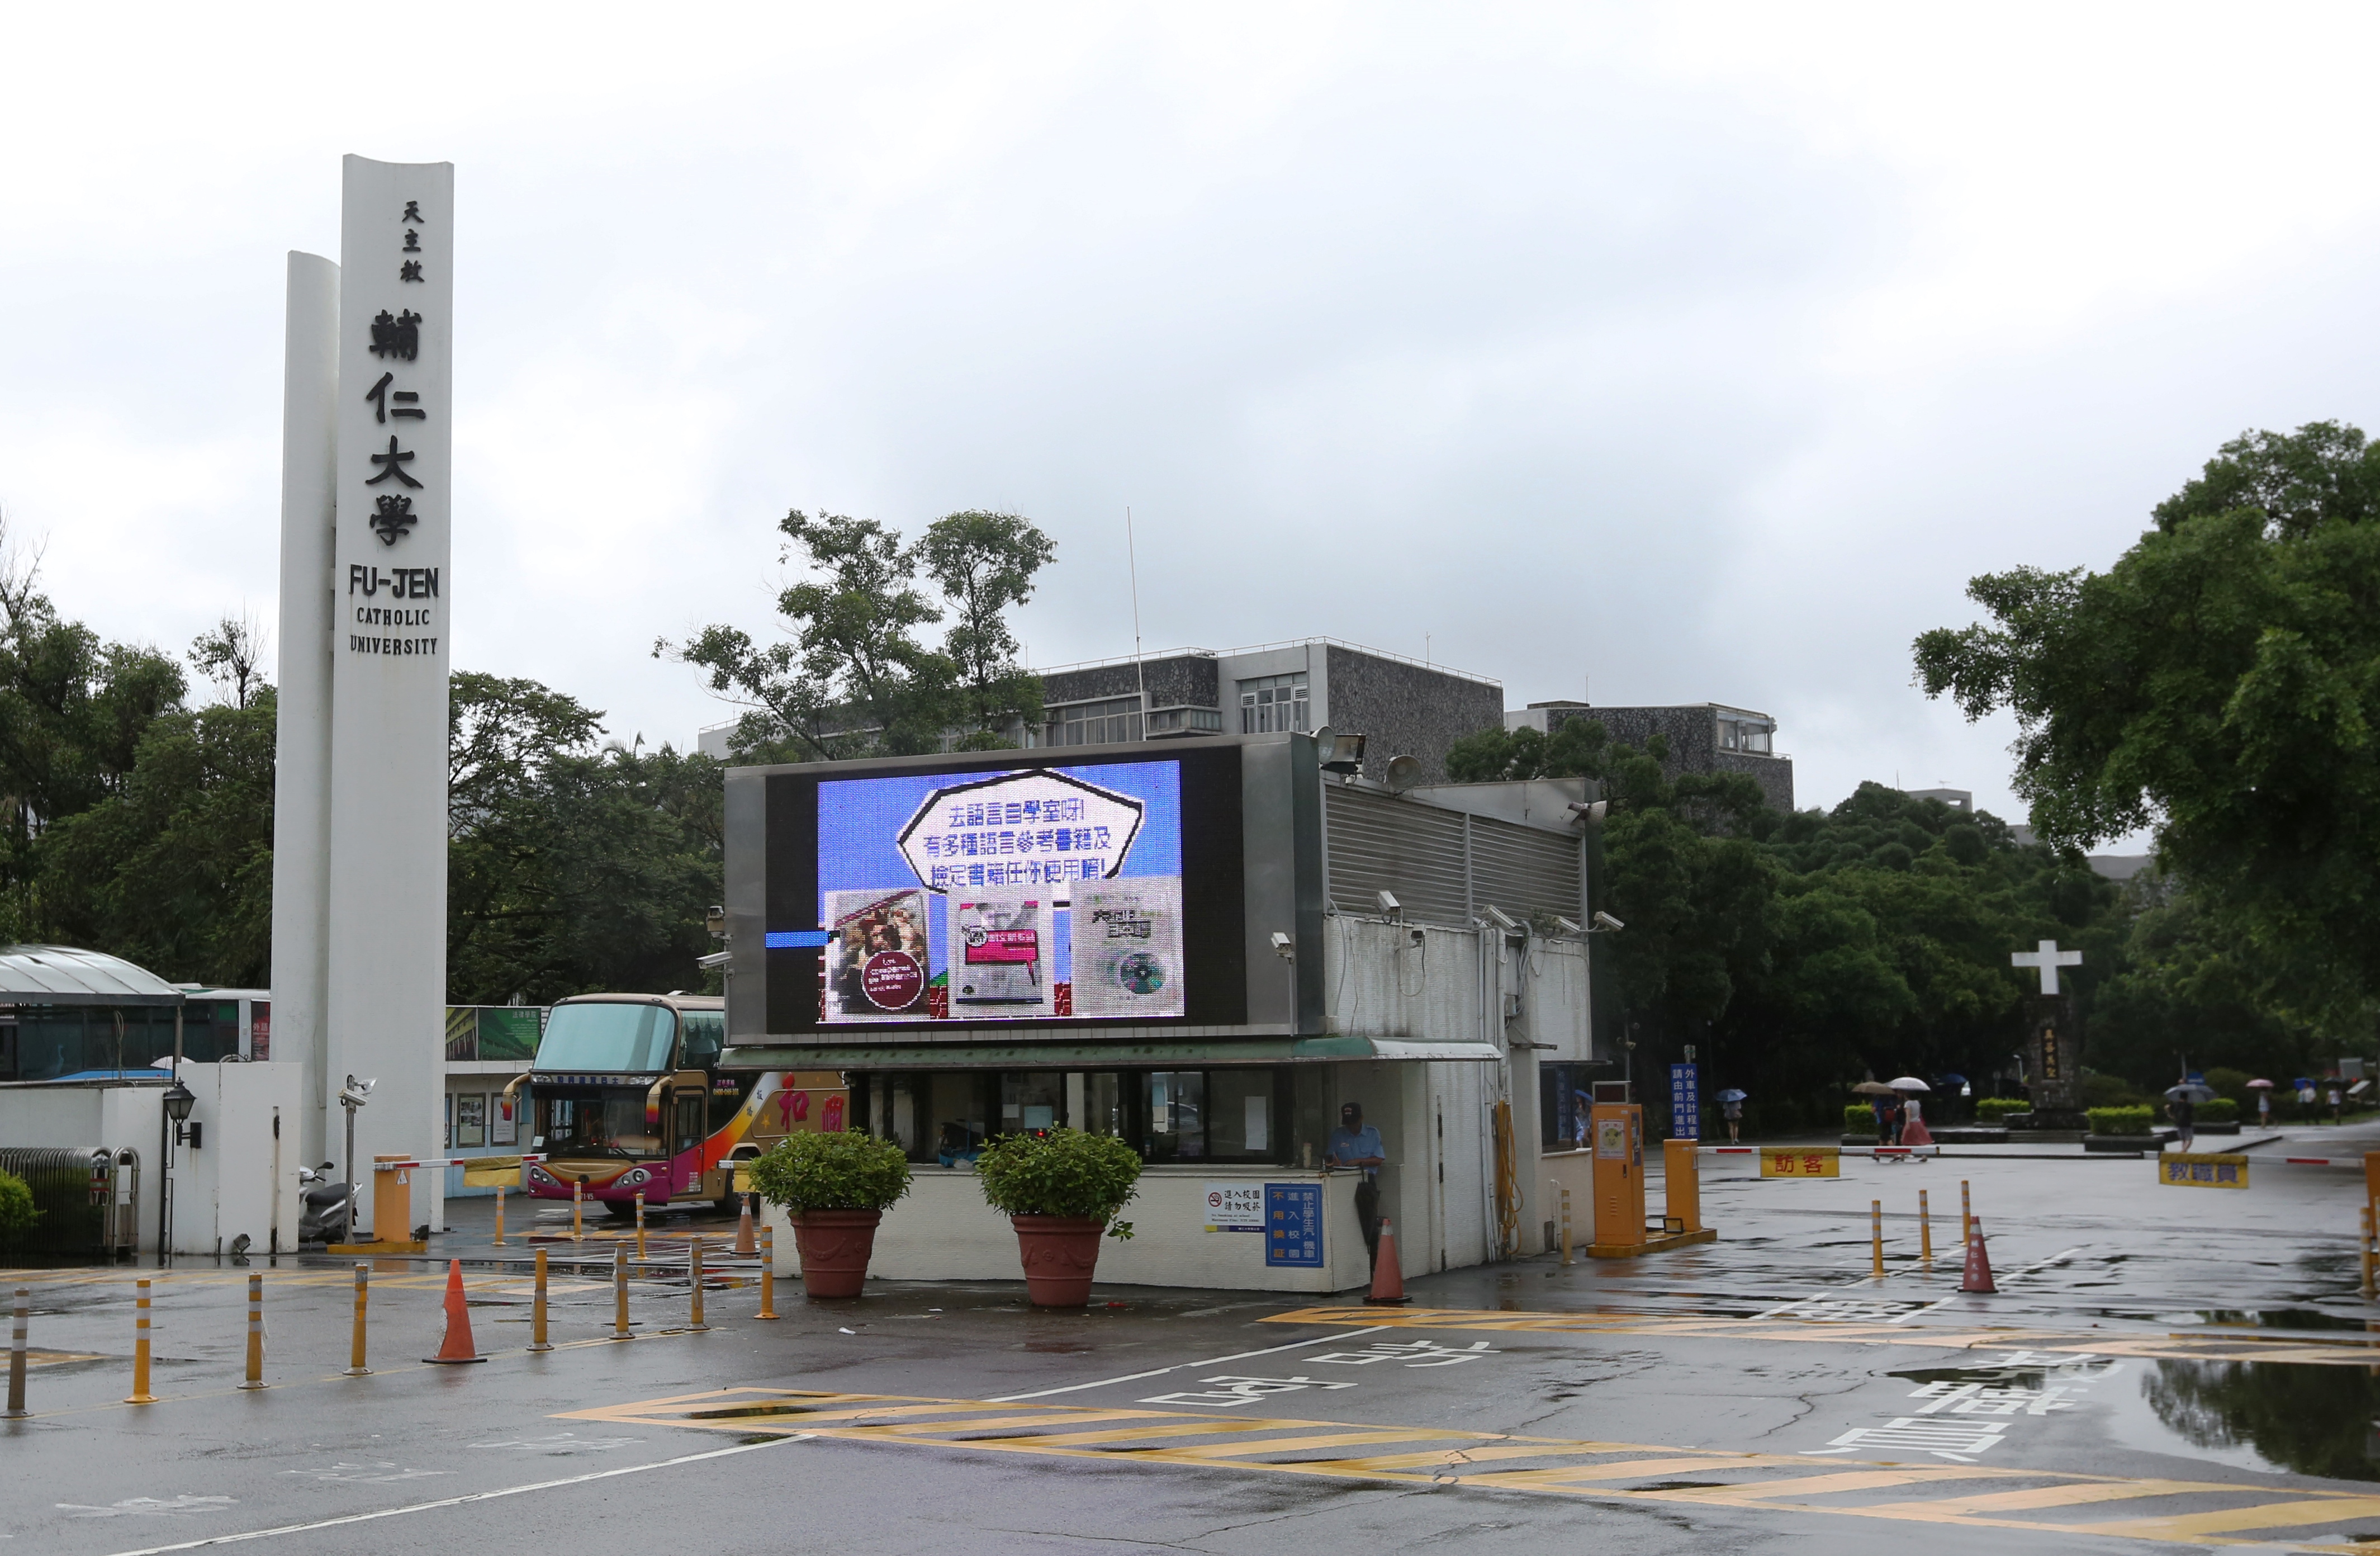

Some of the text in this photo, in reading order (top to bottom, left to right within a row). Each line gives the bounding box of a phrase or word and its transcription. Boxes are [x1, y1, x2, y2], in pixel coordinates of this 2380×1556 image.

[400, 200, 425, 282] 天主教
[365, 308, 426, 546] 輔仁大學
[349, 564, 439, 599] FU-JEN
[357, 607, 430, 626] CATHOLIC
[350, 634, 438, 655] UNIVERSITY
[1672, 1068, 1685, 1136] 請由前門進出
[1685, 1068, 1698, 1136] 外車及計程車
[1775, 1155, 1823, 1174] 訪客
[1224, 1189, 1260, 1200] 進入校園
[1224, 1201, 1261, 1212] 請勿吸菸
[1287, 1191, 1300, 1258] 進入校園
